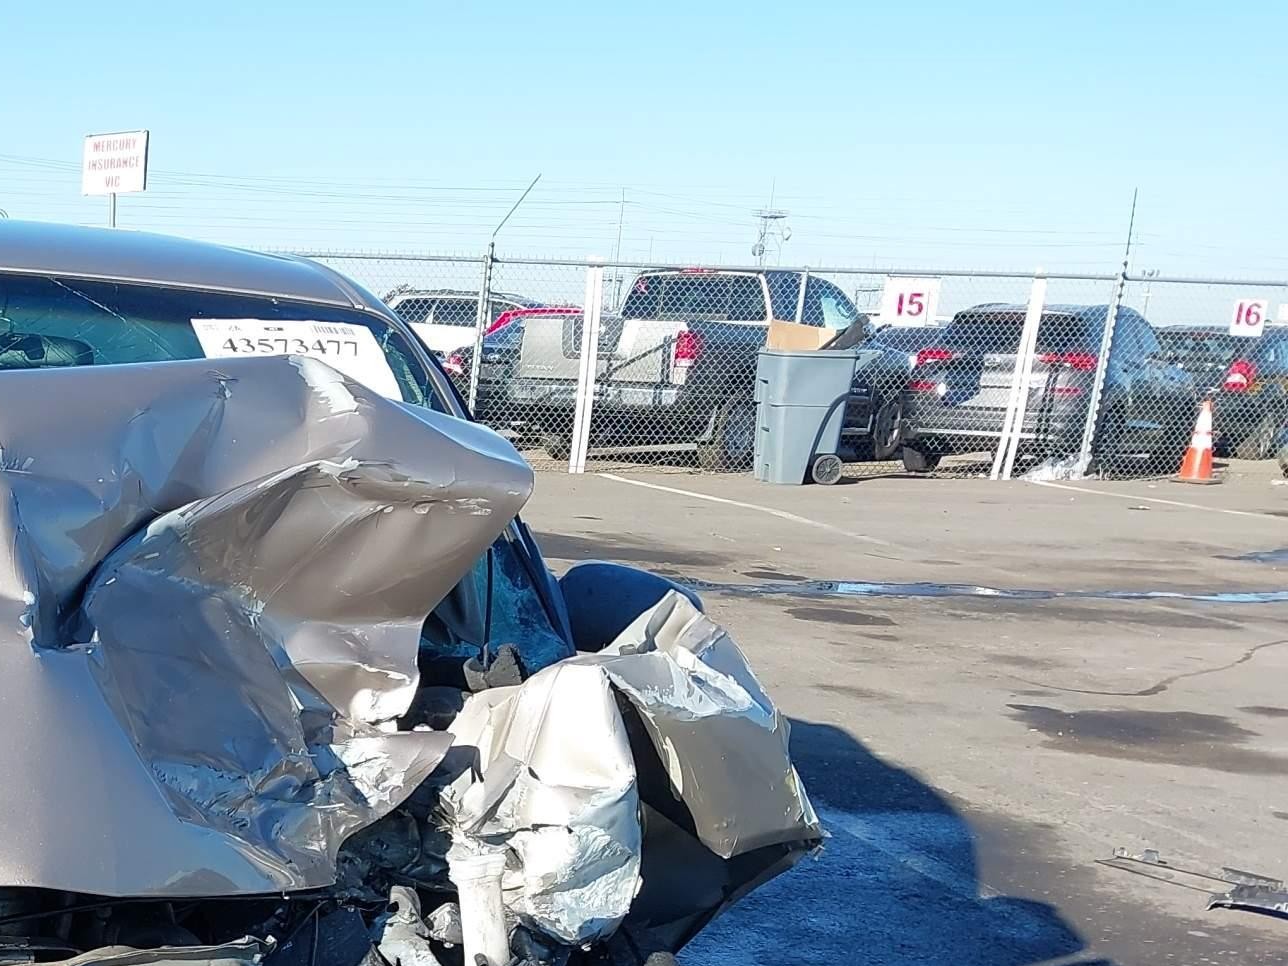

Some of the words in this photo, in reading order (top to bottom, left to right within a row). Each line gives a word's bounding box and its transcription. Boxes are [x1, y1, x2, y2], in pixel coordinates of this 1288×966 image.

[93, 138, 137, 153] MERCURY
[88, 155, 140, 172] INSURANCE
[897, 293, 924, 316] 15
[1235, 302, 1262, 326] 16
[222, 338, 358, 356] 43573477
